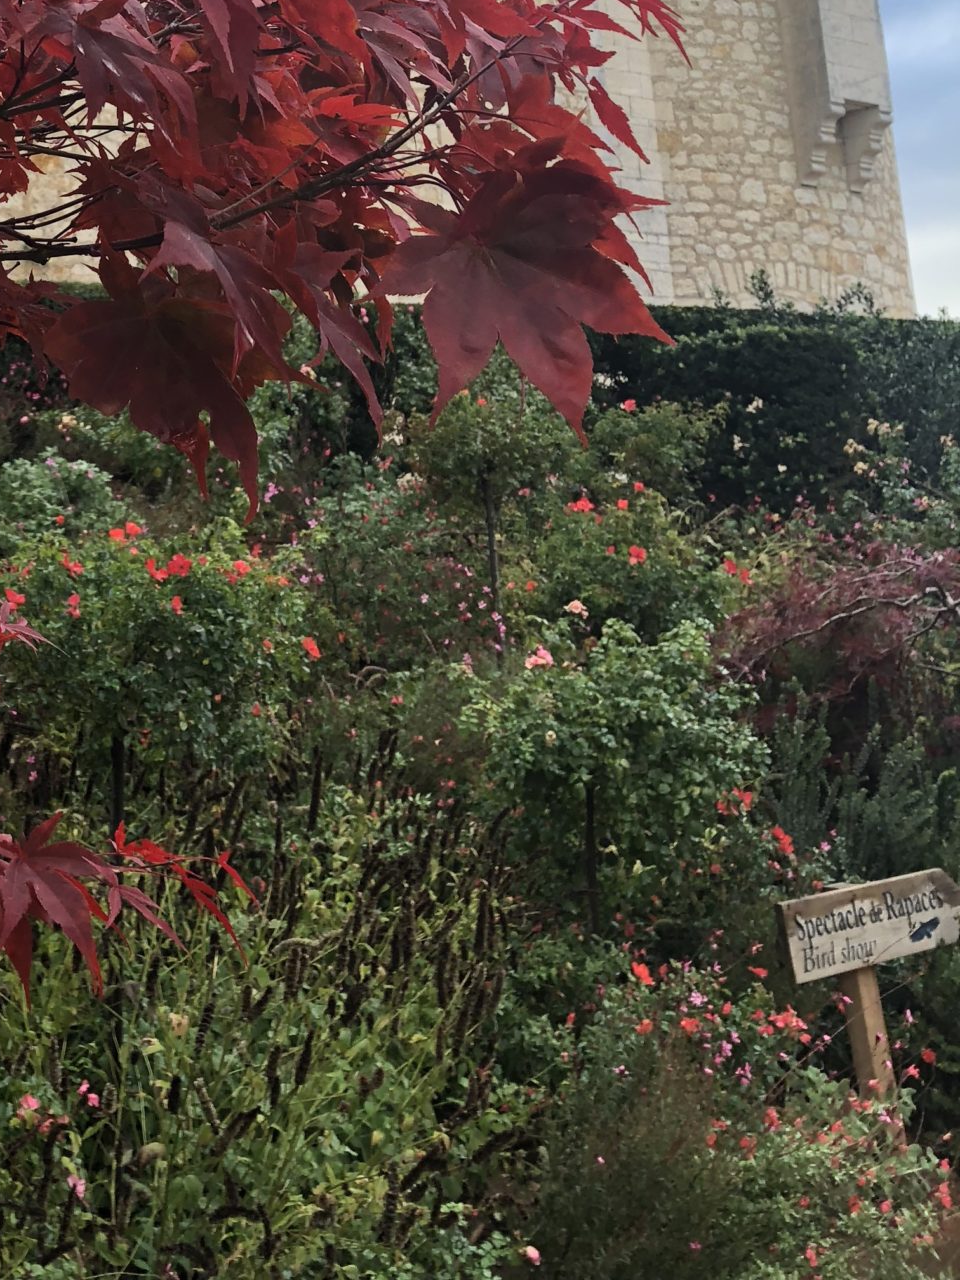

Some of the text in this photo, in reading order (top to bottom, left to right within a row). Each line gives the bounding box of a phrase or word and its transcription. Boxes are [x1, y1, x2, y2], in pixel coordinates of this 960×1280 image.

[794, 891, 944, 949] Spectacle de Rapaces
[803, 937, 877, 974] Bird show
